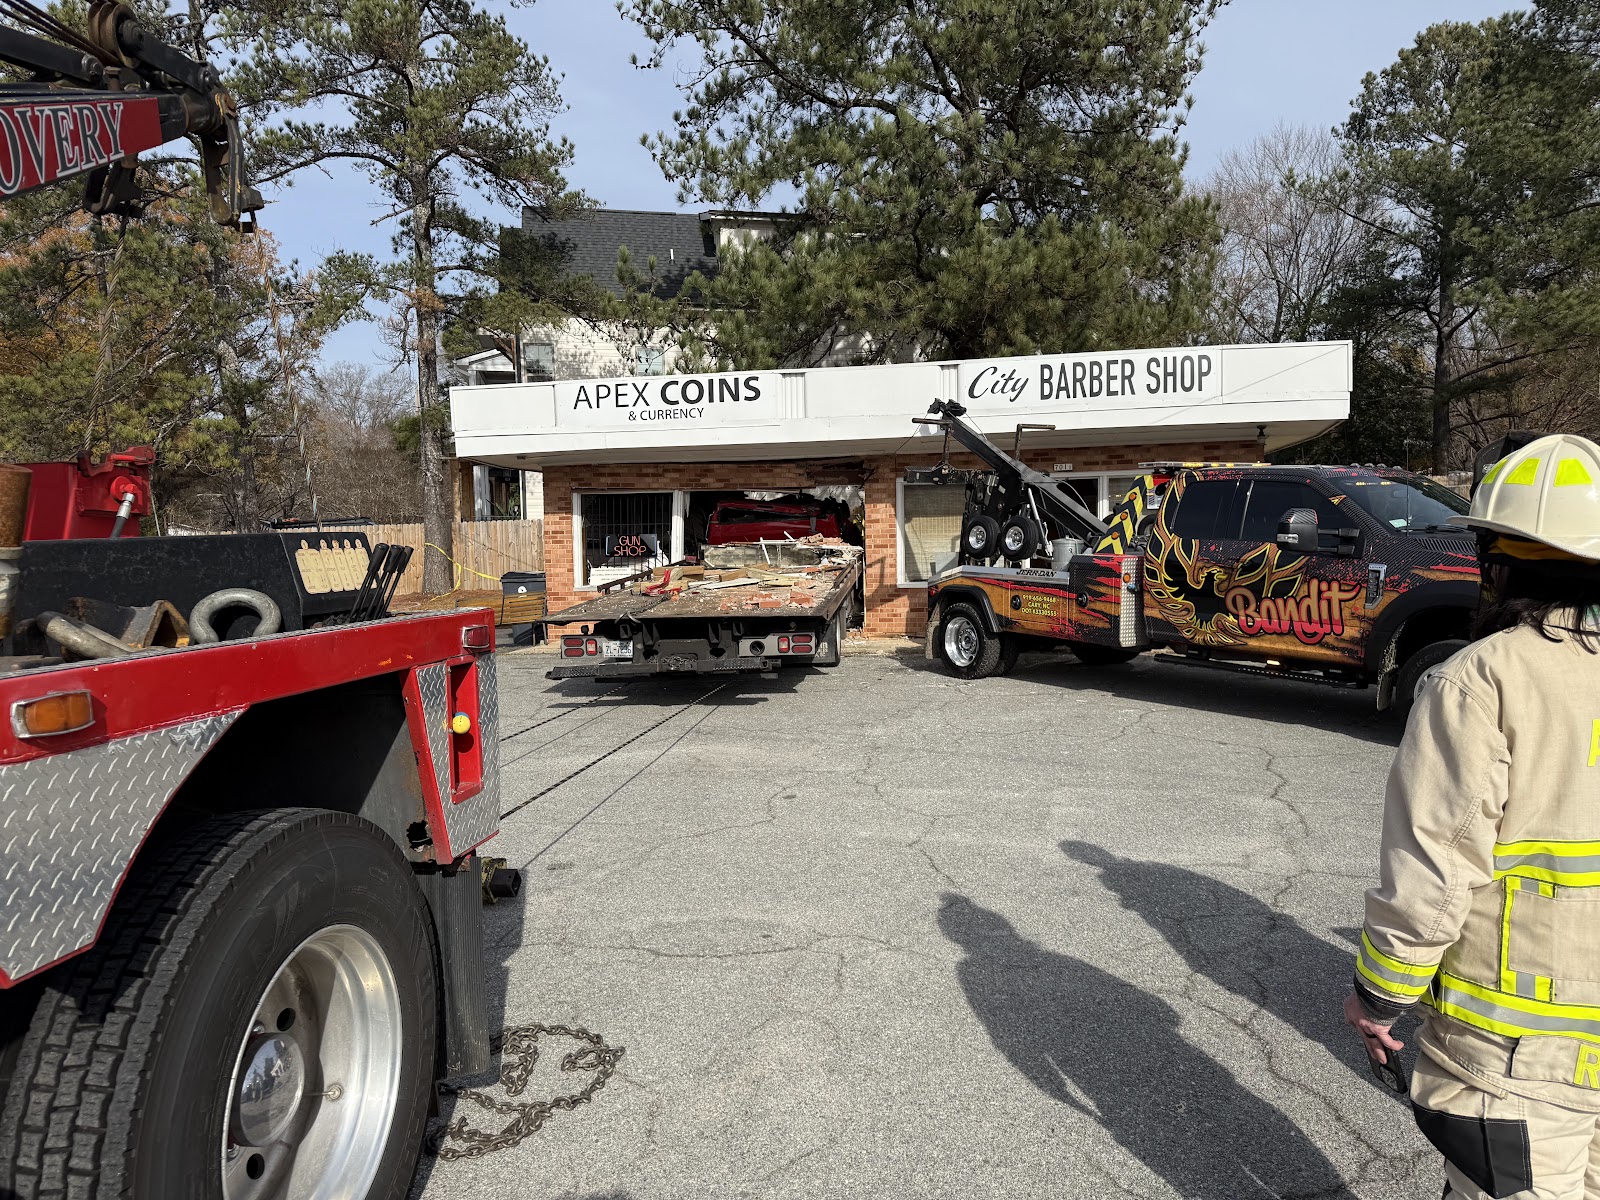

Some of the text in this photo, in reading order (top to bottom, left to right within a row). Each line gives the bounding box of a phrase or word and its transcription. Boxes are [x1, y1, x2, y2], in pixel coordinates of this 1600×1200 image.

[968, 354, 1212, 402] City BARBER SHOP
[573, 376, 761, 410] APEX COINS
[628, 407, 704, 421] & CURRENCY
[614, 545, 647, 556] SHOP
[619, 535, 641, 546] GUN
[1225, 578, 1361, 645] Bandit
